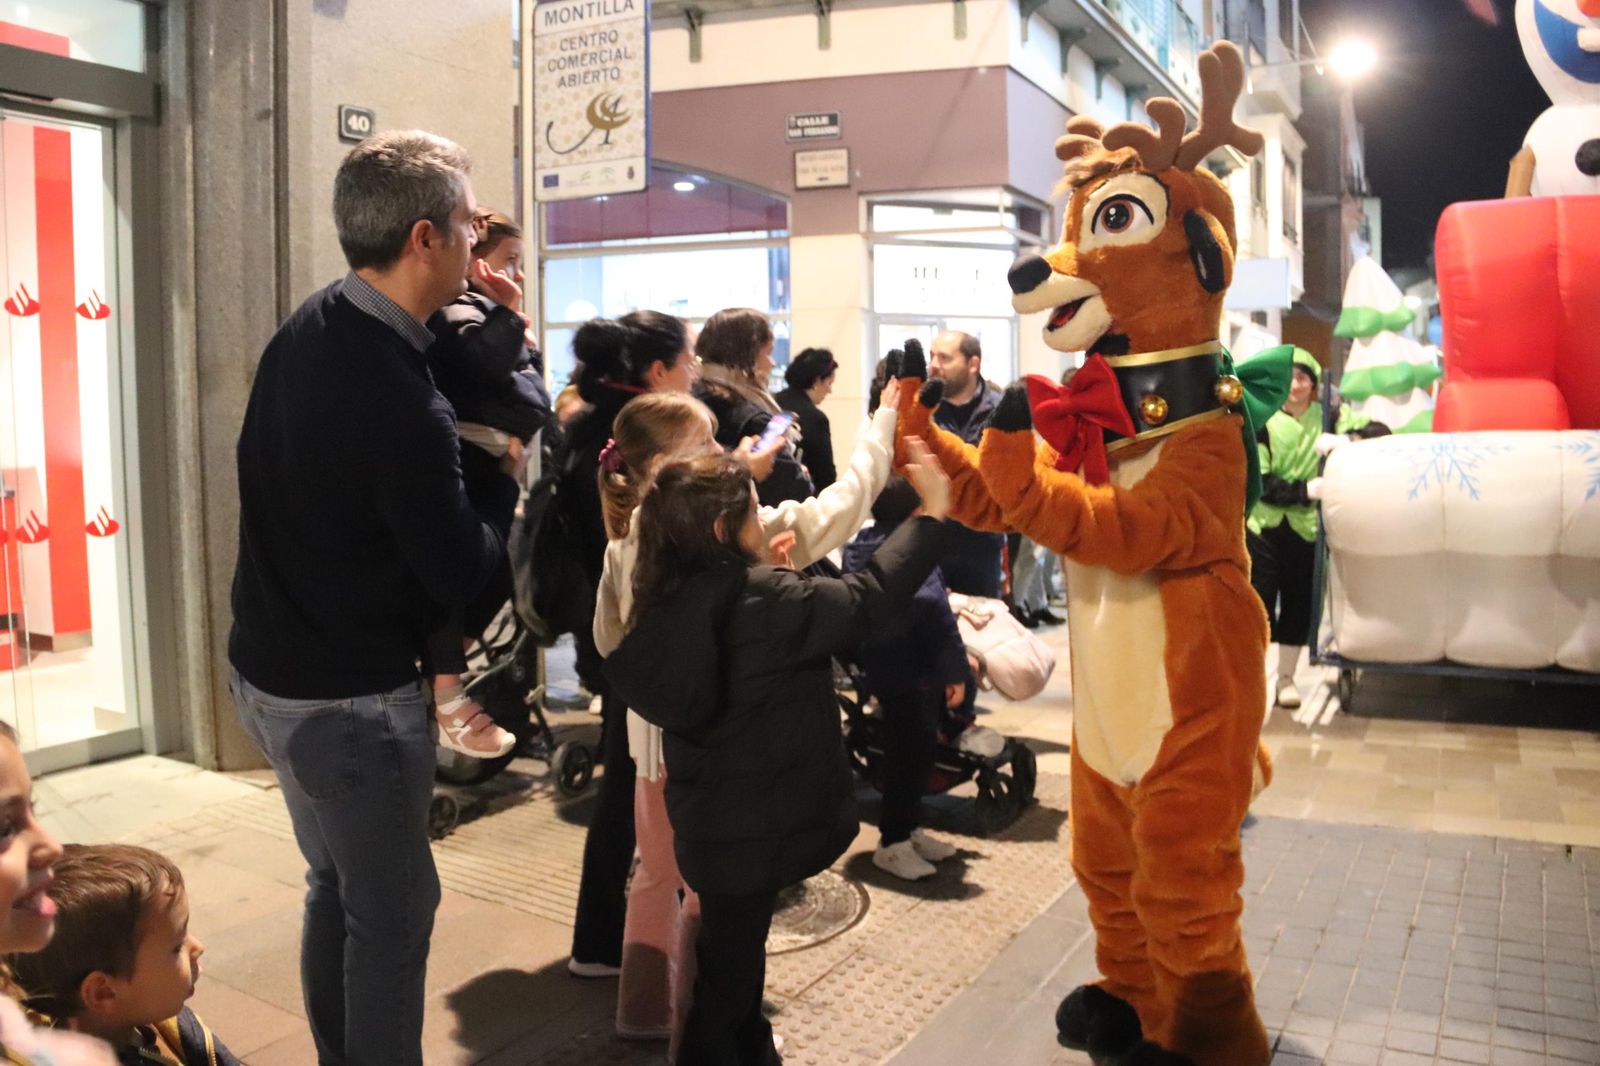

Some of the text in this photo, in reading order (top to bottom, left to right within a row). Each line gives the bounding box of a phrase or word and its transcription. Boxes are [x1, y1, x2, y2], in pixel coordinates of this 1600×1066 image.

[545, 0, 634, 26] MONTILLA
[560, 29, 618, 52] CENTRO
[548, 47, 631, 72] COMERCIAL
[558, 66, 621, 88] ABIERTO
[348, 114, 370, 132] 40
